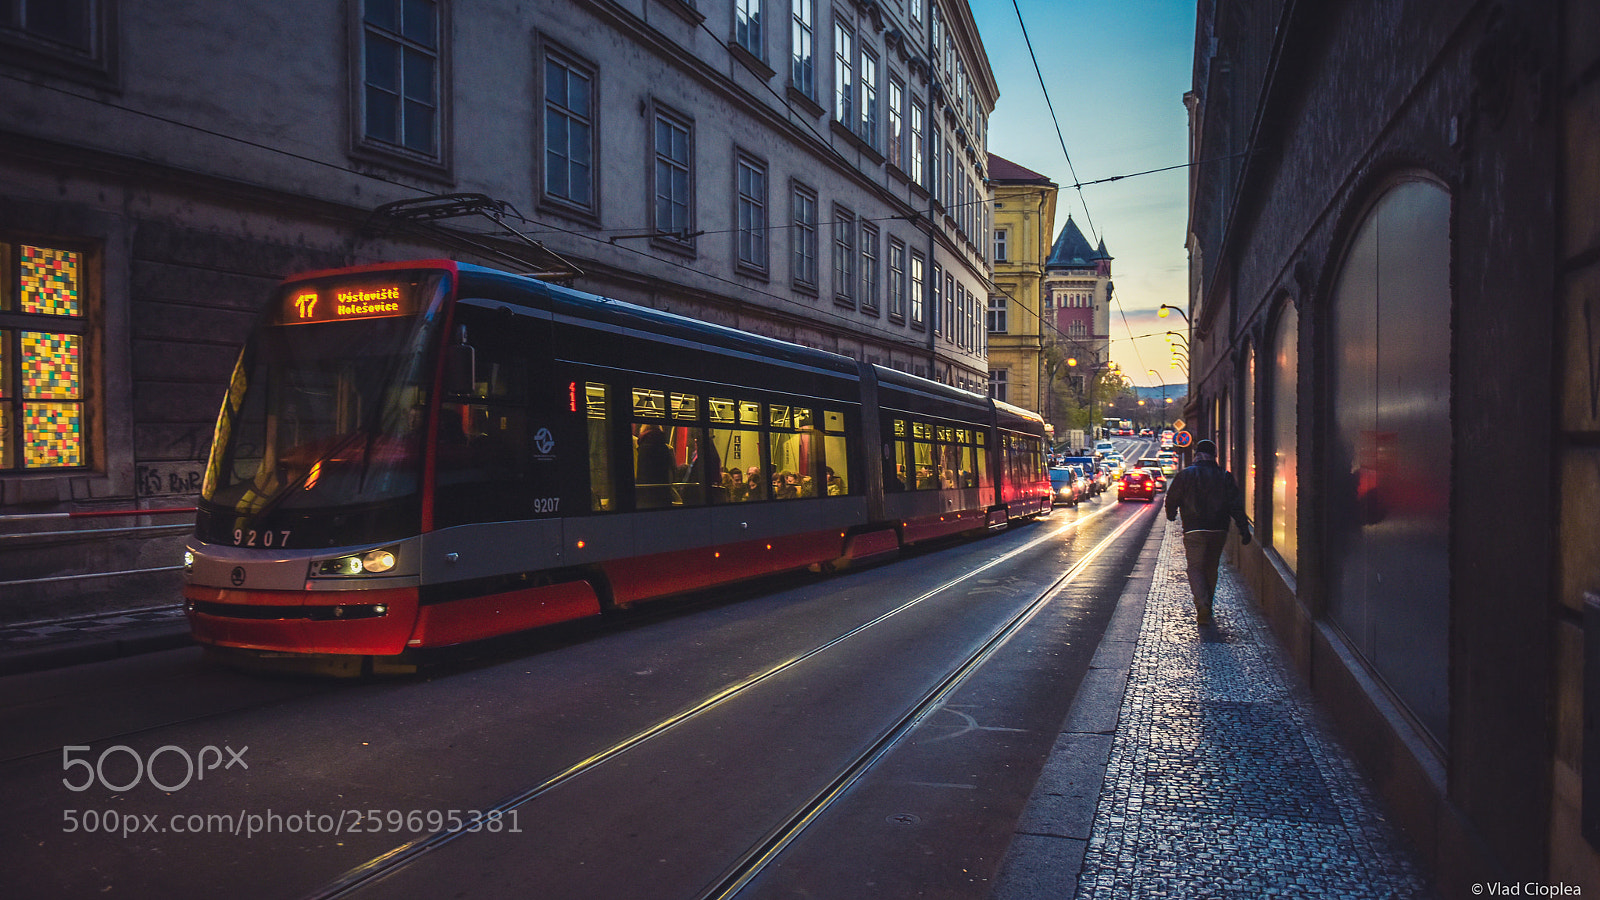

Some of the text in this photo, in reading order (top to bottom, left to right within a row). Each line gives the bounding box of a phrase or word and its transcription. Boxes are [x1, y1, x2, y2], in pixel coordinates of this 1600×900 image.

[337, 287, 400, 303] Výstaviště
[294, 294, 318, 318] 17
[337, 302, 399, 315] Holešovice
[534, 497, 560, 513] 9207
[233, 529, 291, 547] 9207
